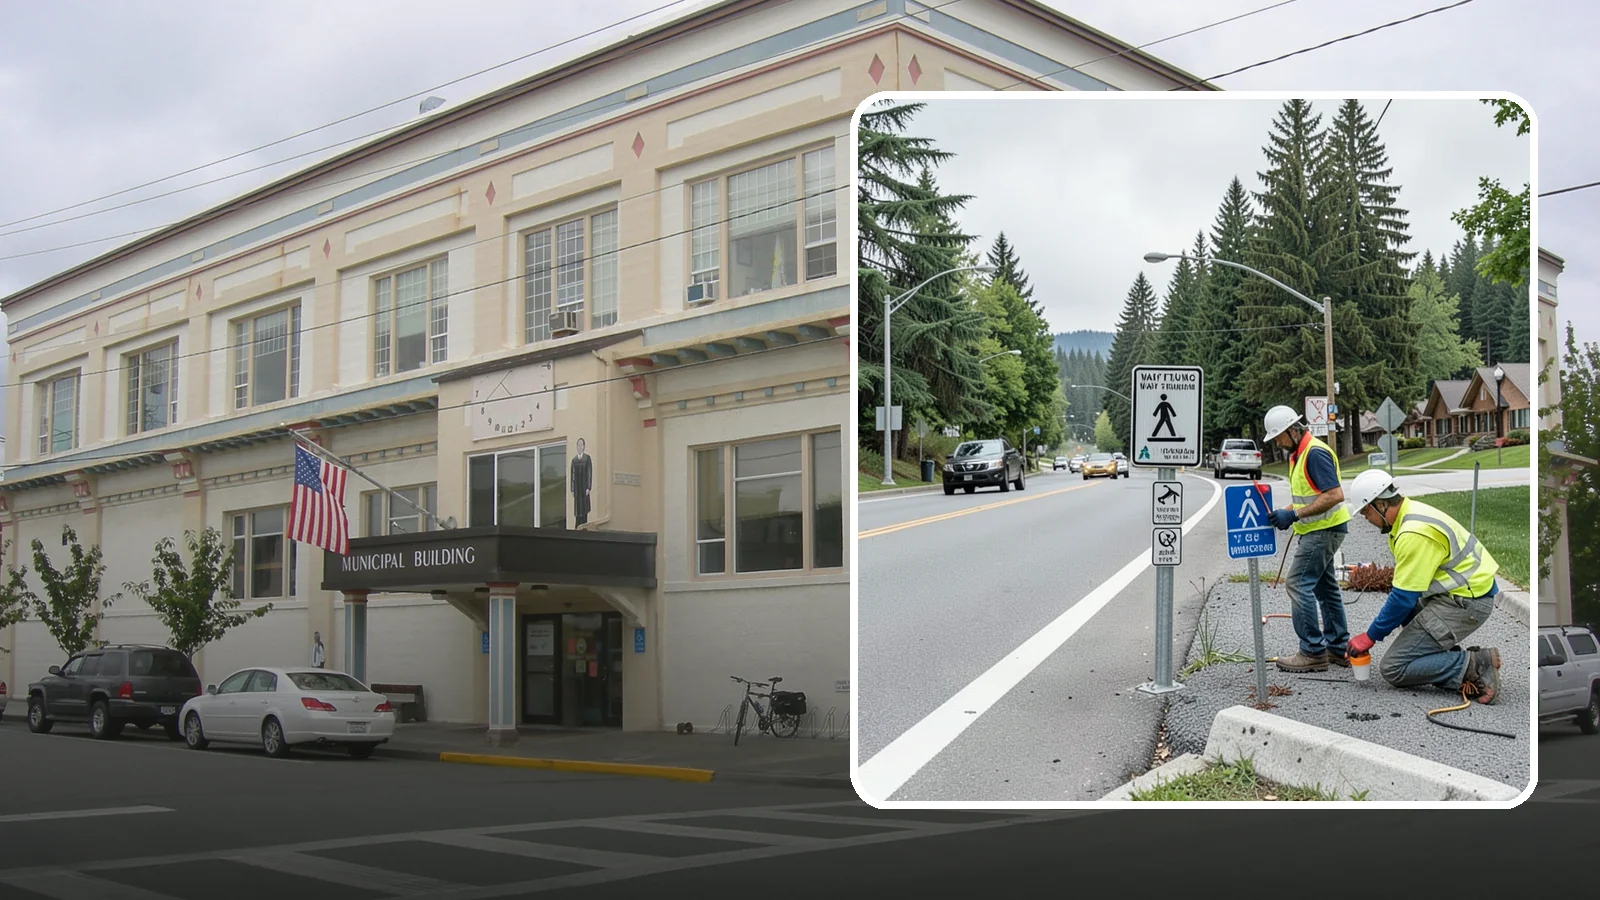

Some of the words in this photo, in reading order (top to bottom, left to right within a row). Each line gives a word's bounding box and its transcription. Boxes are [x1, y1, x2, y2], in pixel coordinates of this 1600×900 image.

[494, 423, 500, 431] 10
[521, 420, 526, 428] 2
[507, 425, 513, 433] 12
[342, 552, 405, 572] MUNICIPAL
[414, 546, 475, 567] BUILDING
